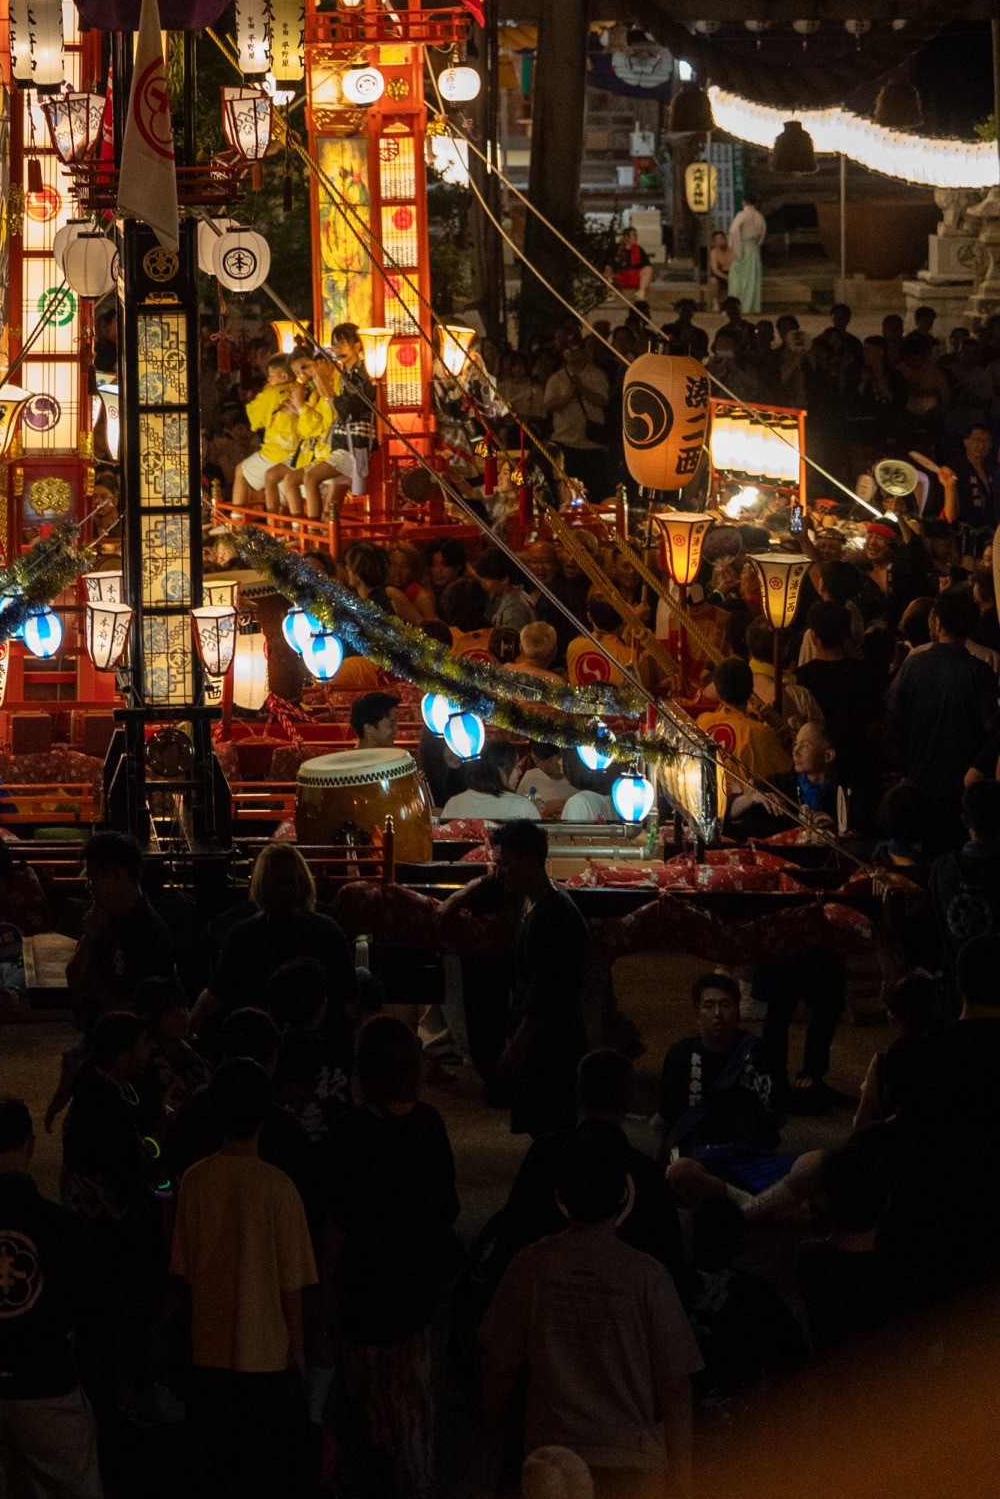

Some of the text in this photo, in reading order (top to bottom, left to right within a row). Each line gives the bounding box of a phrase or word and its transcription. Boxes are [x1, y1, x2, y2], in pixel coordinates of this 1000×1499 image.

[675, 375, 709, 475] 湊二西
[96, 616, 109, 652] 本府中
